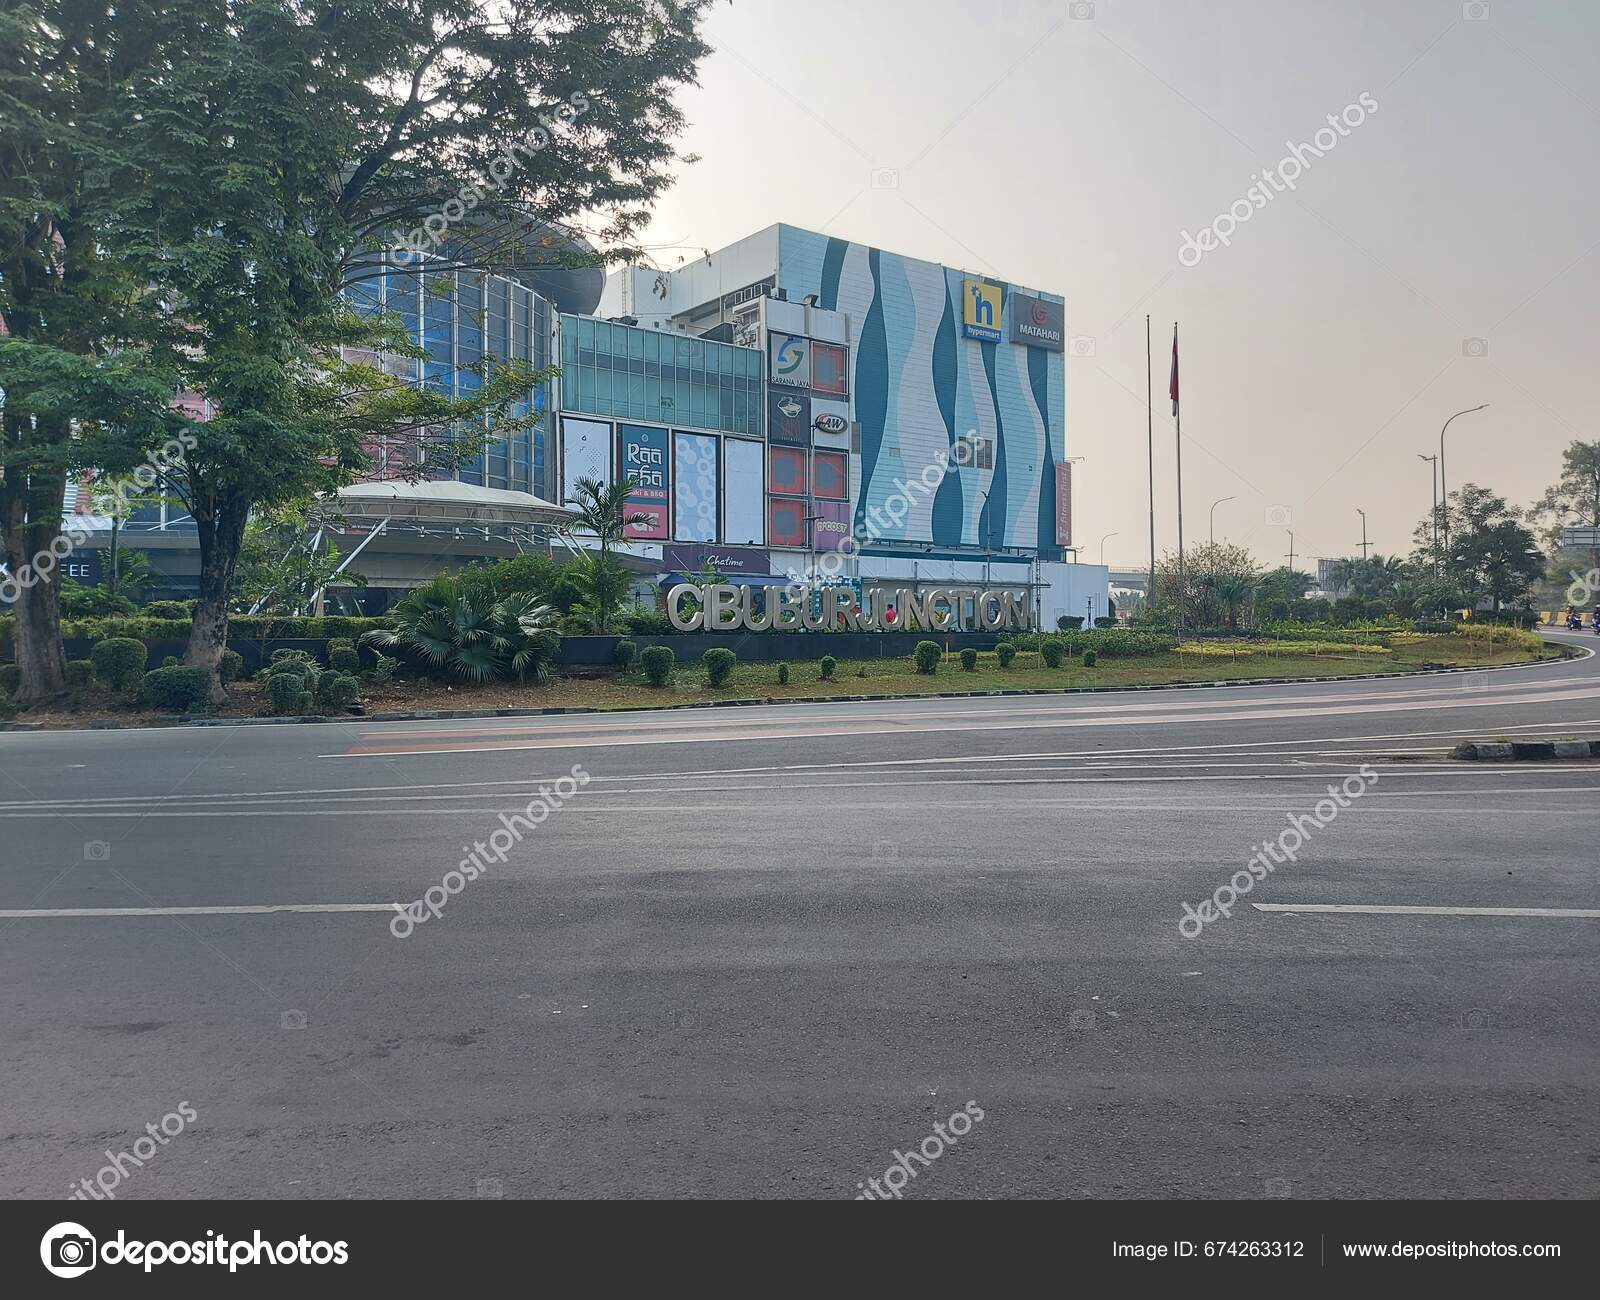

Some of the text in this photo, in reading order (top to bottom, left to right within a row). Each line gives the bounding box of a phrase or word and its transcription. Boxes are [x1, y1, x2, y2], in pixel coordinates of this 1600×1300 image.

[968, 326, 1000, 340] hypermart
[1019, 324, 1060, 342] MATAHARI
[706, 555, 744, 567] Chatime
[667, 583, 1030, 632] CIBUBUR JUNCTION
